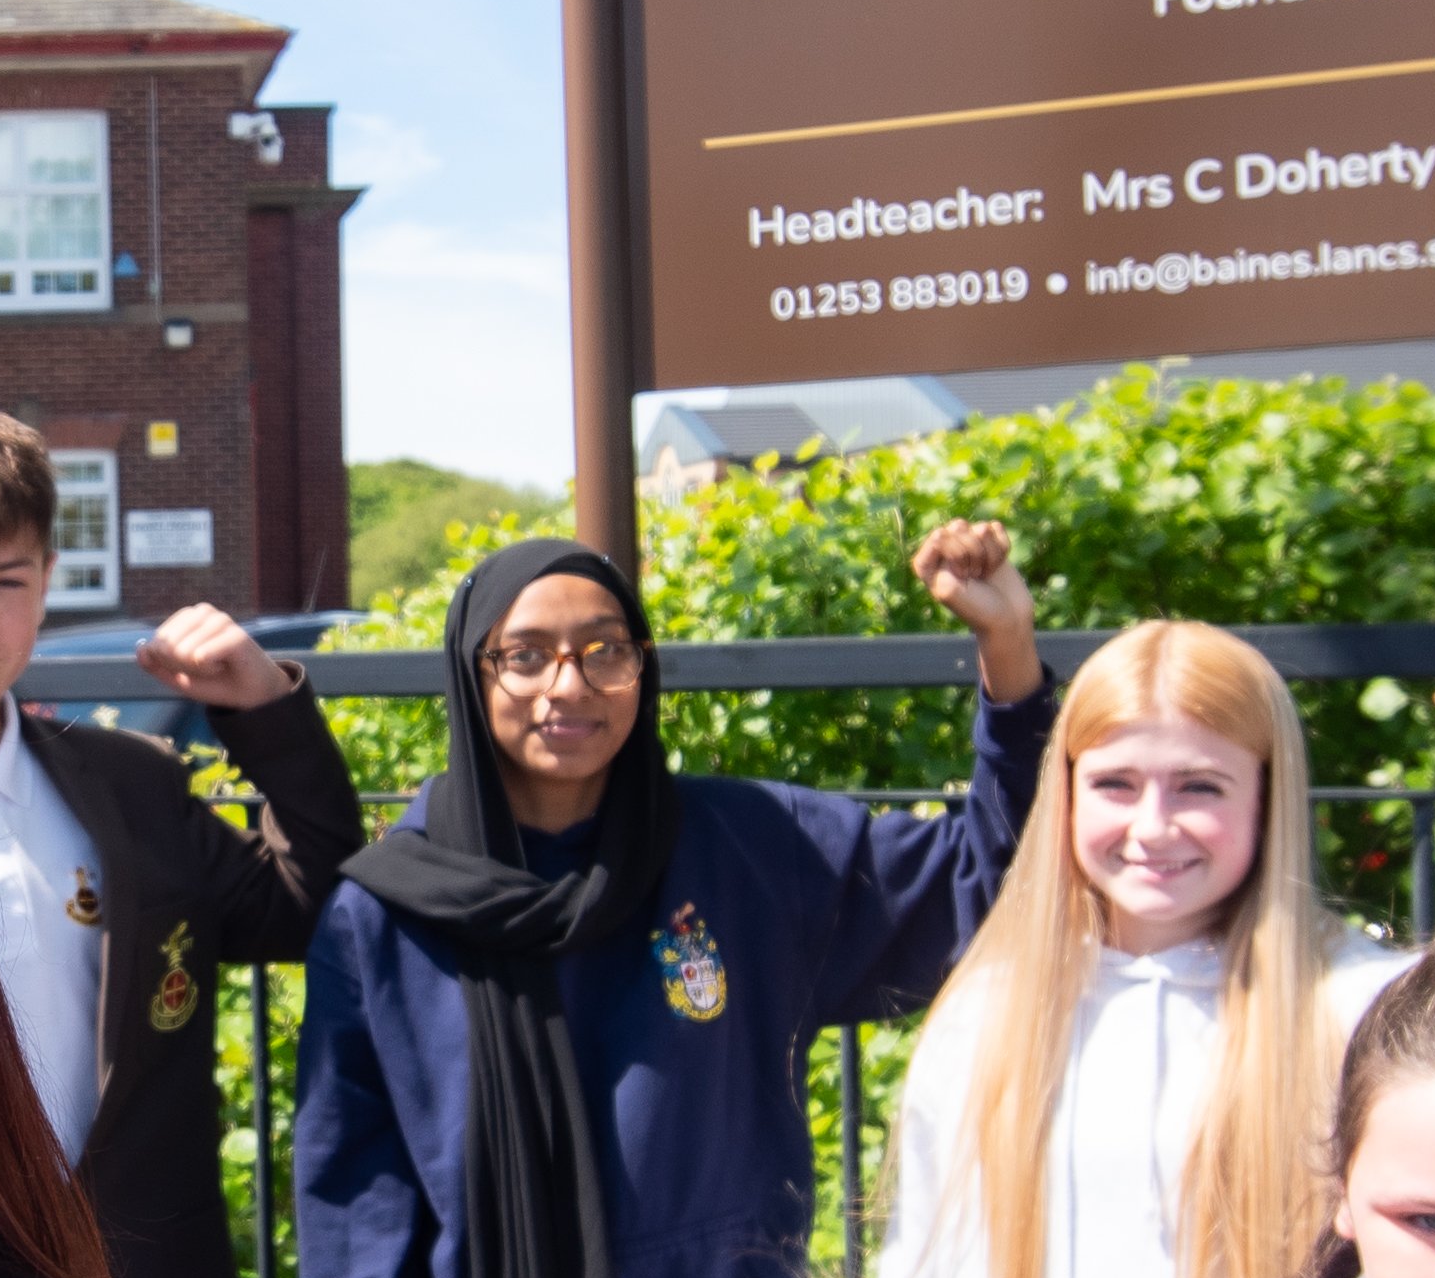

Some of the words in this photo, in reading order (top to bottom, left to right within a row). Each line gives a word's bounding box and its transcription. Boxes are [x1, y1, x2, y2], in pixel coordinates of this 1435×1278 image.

[747, 186, 1044, 249] Headteacher:
[1081, 169, 1174, 215] Mrs
[1183, 157, 1223, 204] C
[769, 279, 883, 322] 01253
[888, 266, 1030, 312] 883019
